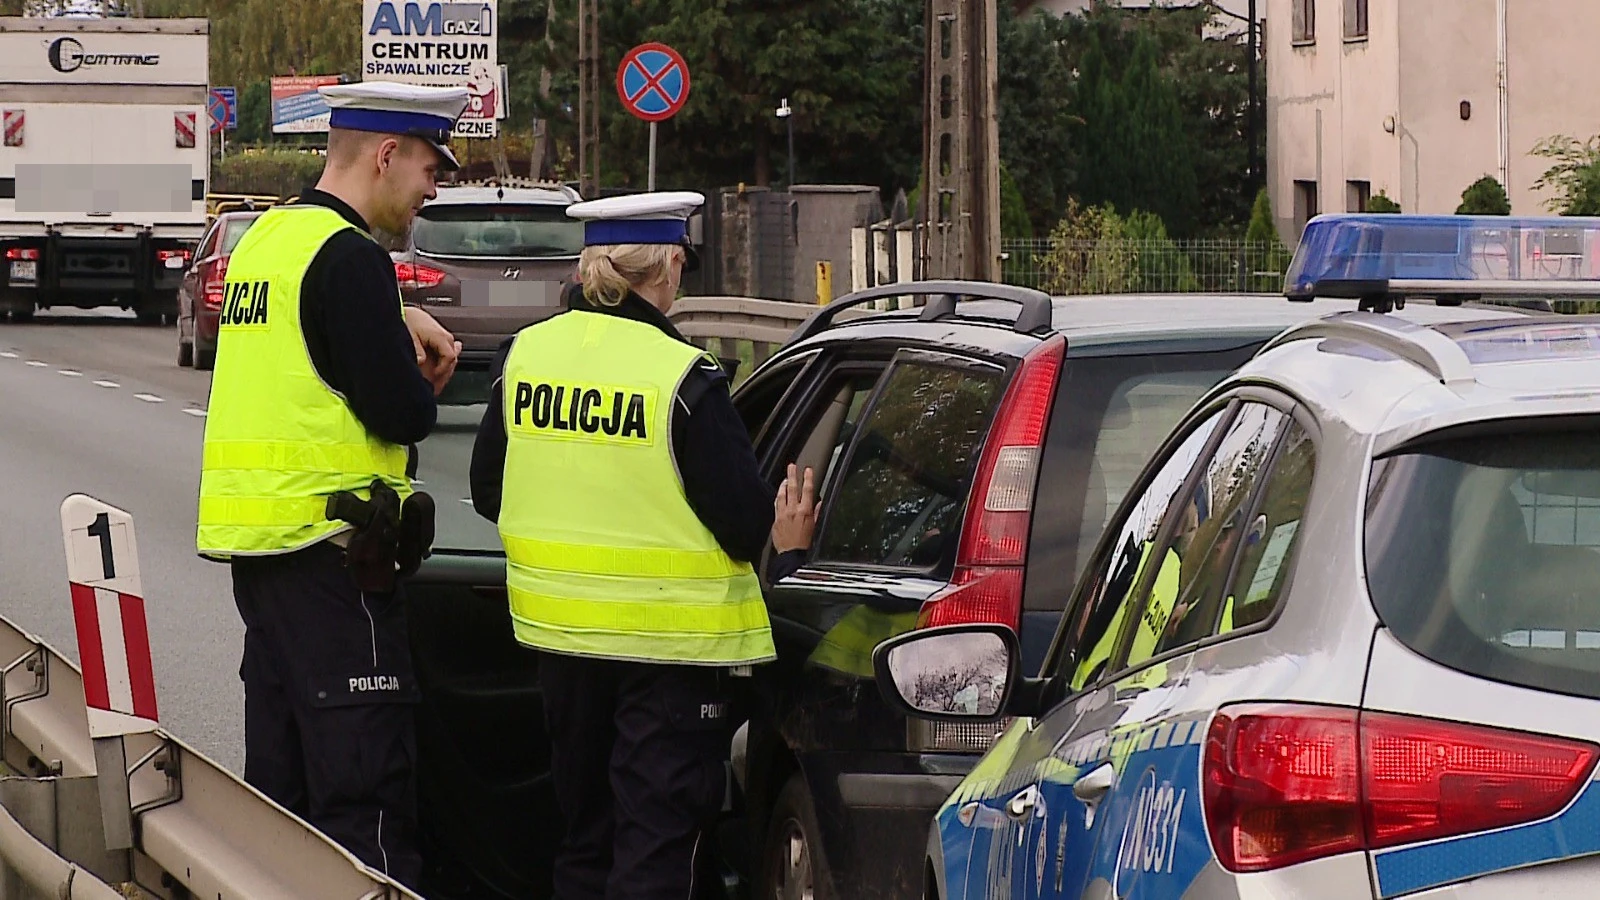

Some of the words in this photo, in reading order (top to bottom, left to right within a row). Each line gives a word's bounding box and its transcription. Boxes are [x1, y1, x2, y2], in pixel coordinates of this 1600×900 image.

[369, 2, 442, 36] AM
[443, 19, 481, 35] GAZ
[371, 42, 488, 60] CENTRUM
[366, 62, 470, 76] SPAWALNICZE
[220, 281, 269, 325] LICJA
[514, 381, 647, 439] POLICJA
[87, 512, 116, 580] 1
[348, 675, 400, 693] POLICJA
